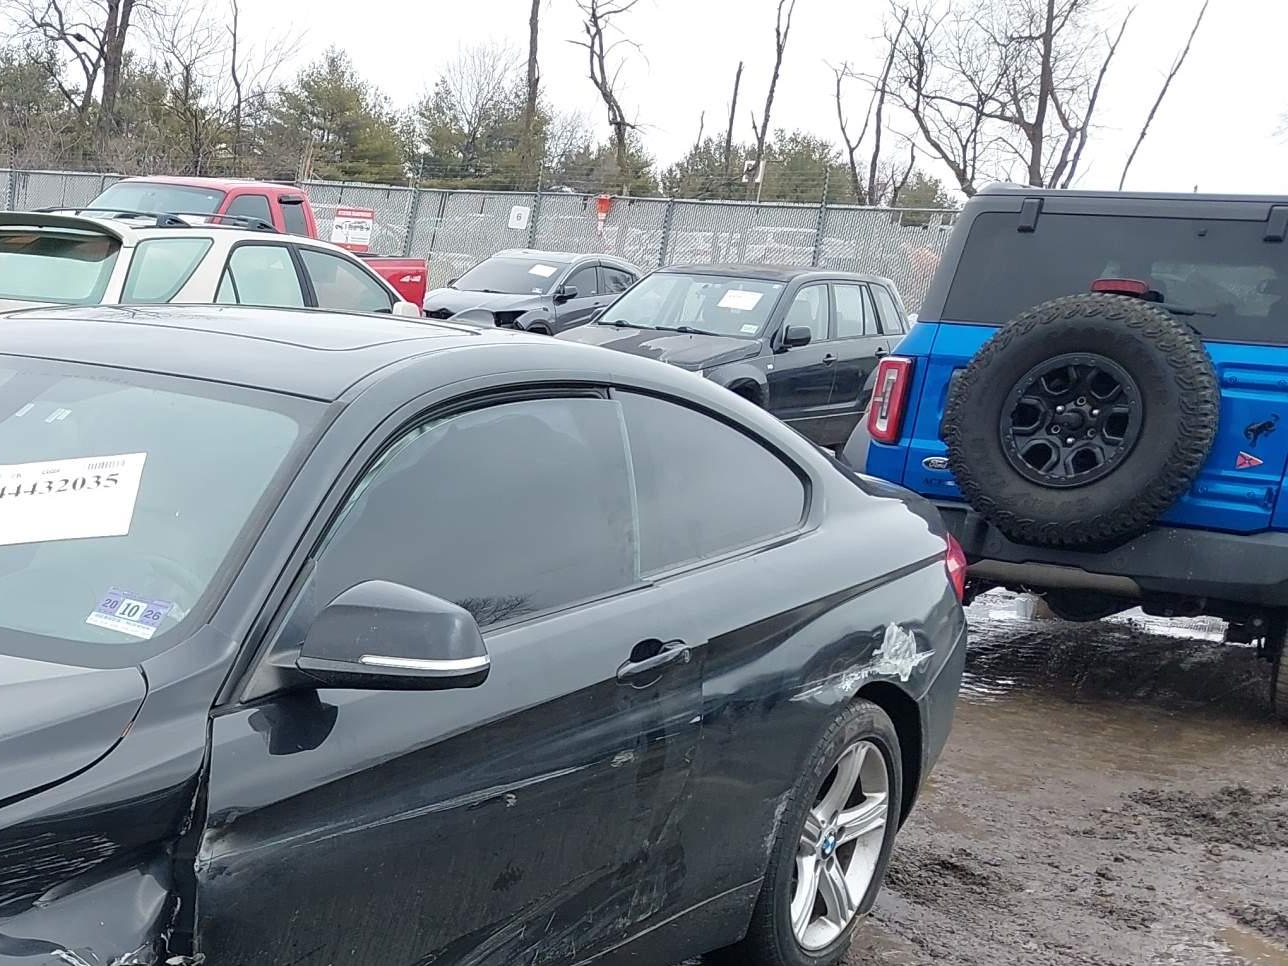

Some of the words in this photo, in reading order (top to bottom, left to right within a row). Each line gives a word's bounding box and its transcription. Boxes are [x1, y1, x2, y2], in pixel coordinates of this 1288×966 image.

[102, 598, 119, 609] 20
[119, 602, 140, 618] 10
[143, 609, 162, 621] 26
